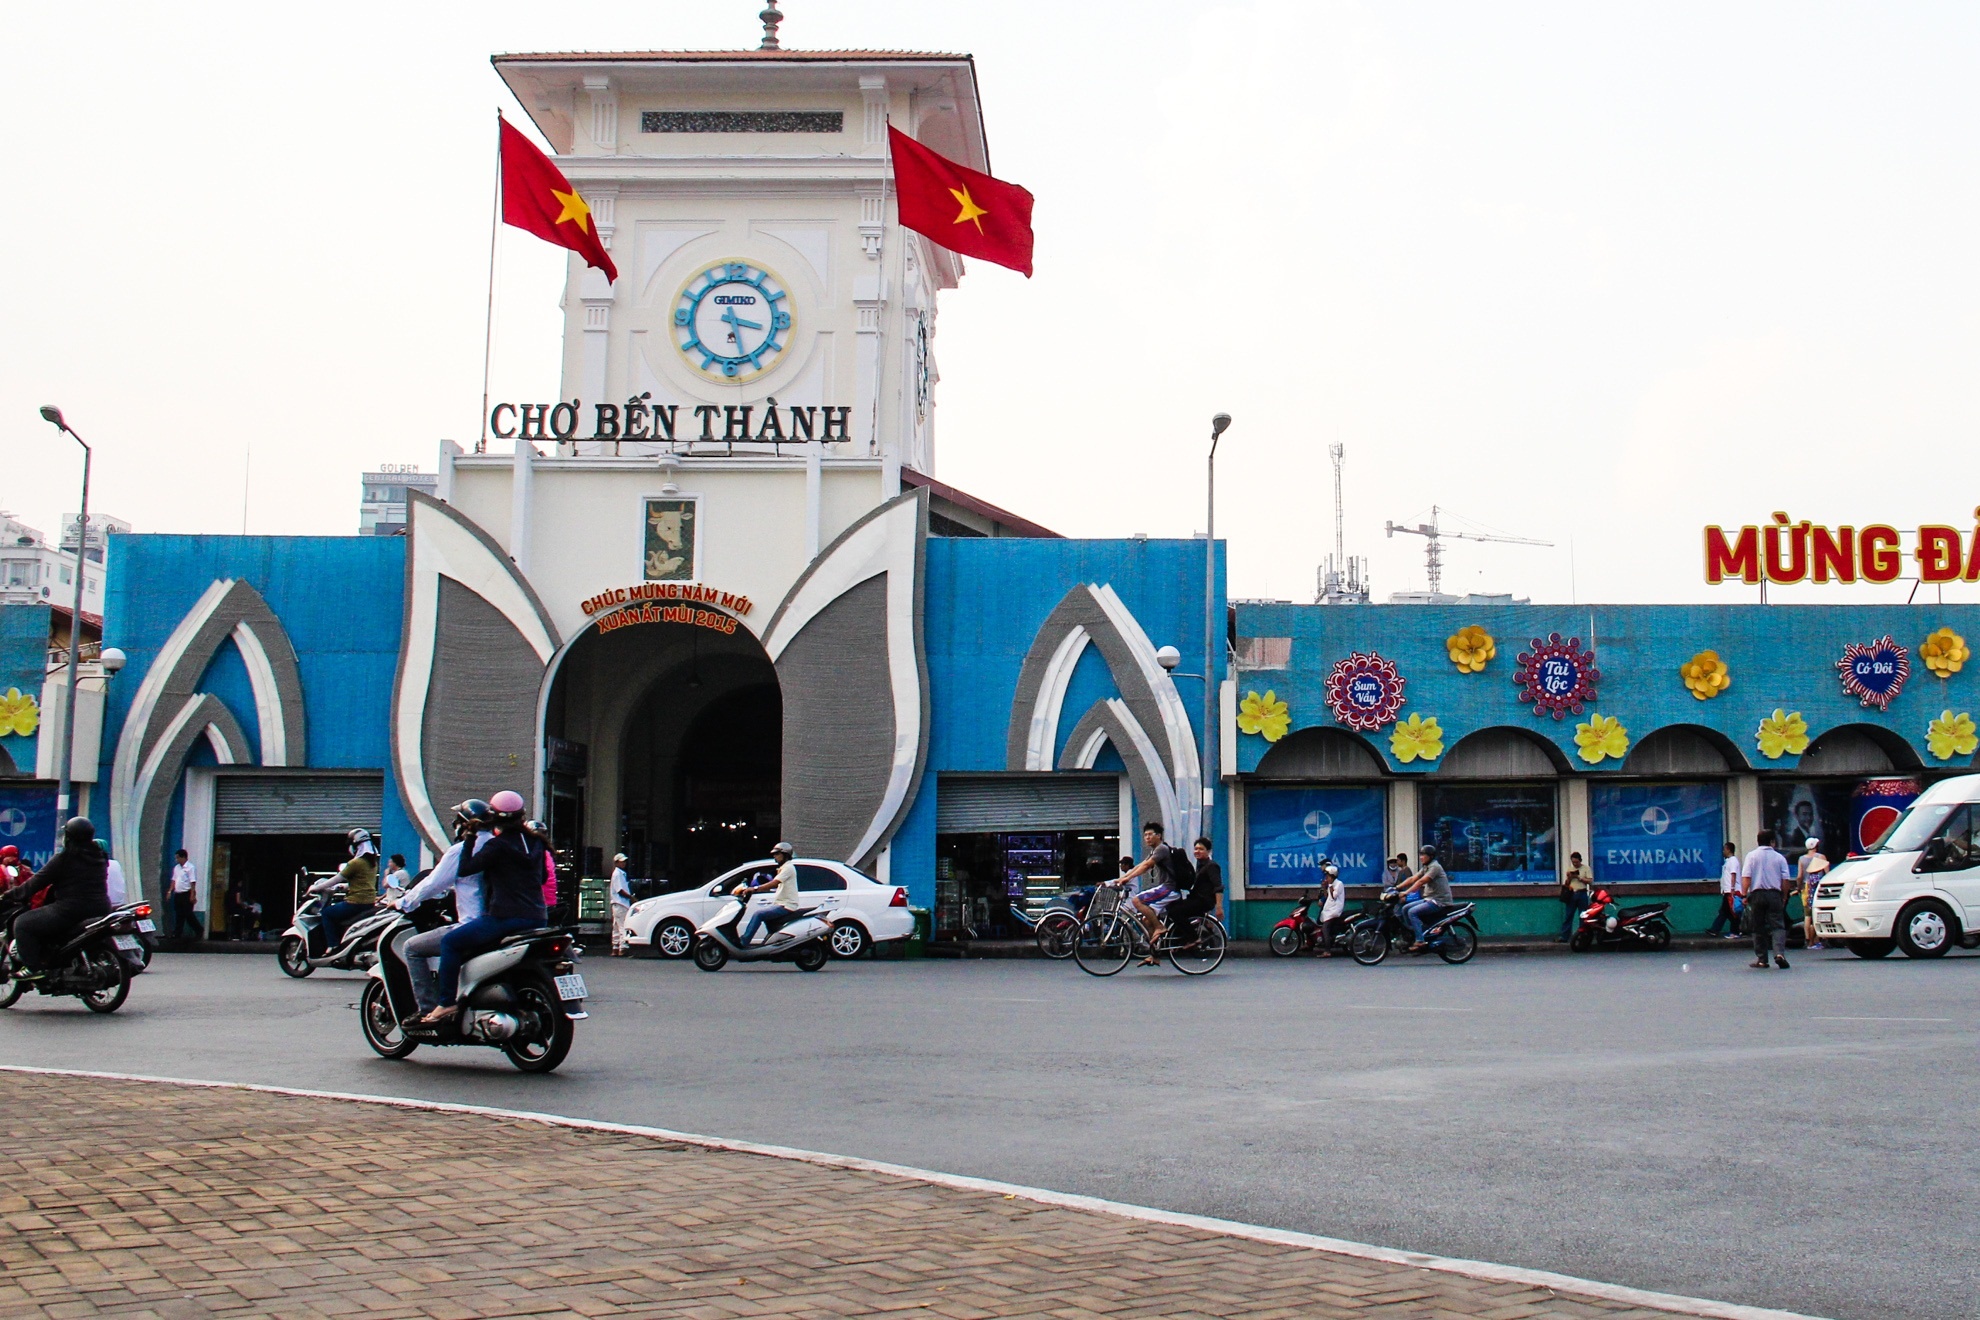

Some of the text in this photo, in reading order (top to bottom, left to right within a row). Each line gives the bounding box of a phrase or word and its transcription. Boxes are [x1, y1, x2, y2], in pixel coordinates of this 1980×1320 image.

[714, 295, 756, 305] GIMIKO
[491, 392, 853, 445] CHỢ BẾN THÀNH
[380, 463, 419, 473] GOLDEN
[1704, 511, 1901, 585] MỪNG
[580, 581, 753, 616] CHÚC MỪNG NĂM MỚI
[596, 607, 640, 634] XUÂN
[641, 602, 663, 624] ẤT
[696, 611, 738, 635] 2015
[1545, 661, 1569, 676] Tài
[1856, 662, 1893, 675] Có Đôi
[1354, 681, 1377, 691] Sum
[1545, 676, 1568, 694] Lộc
[1607, 849, 1704, 864] EXIMBANK
[407, 1029, 438, 1037] HONDA
